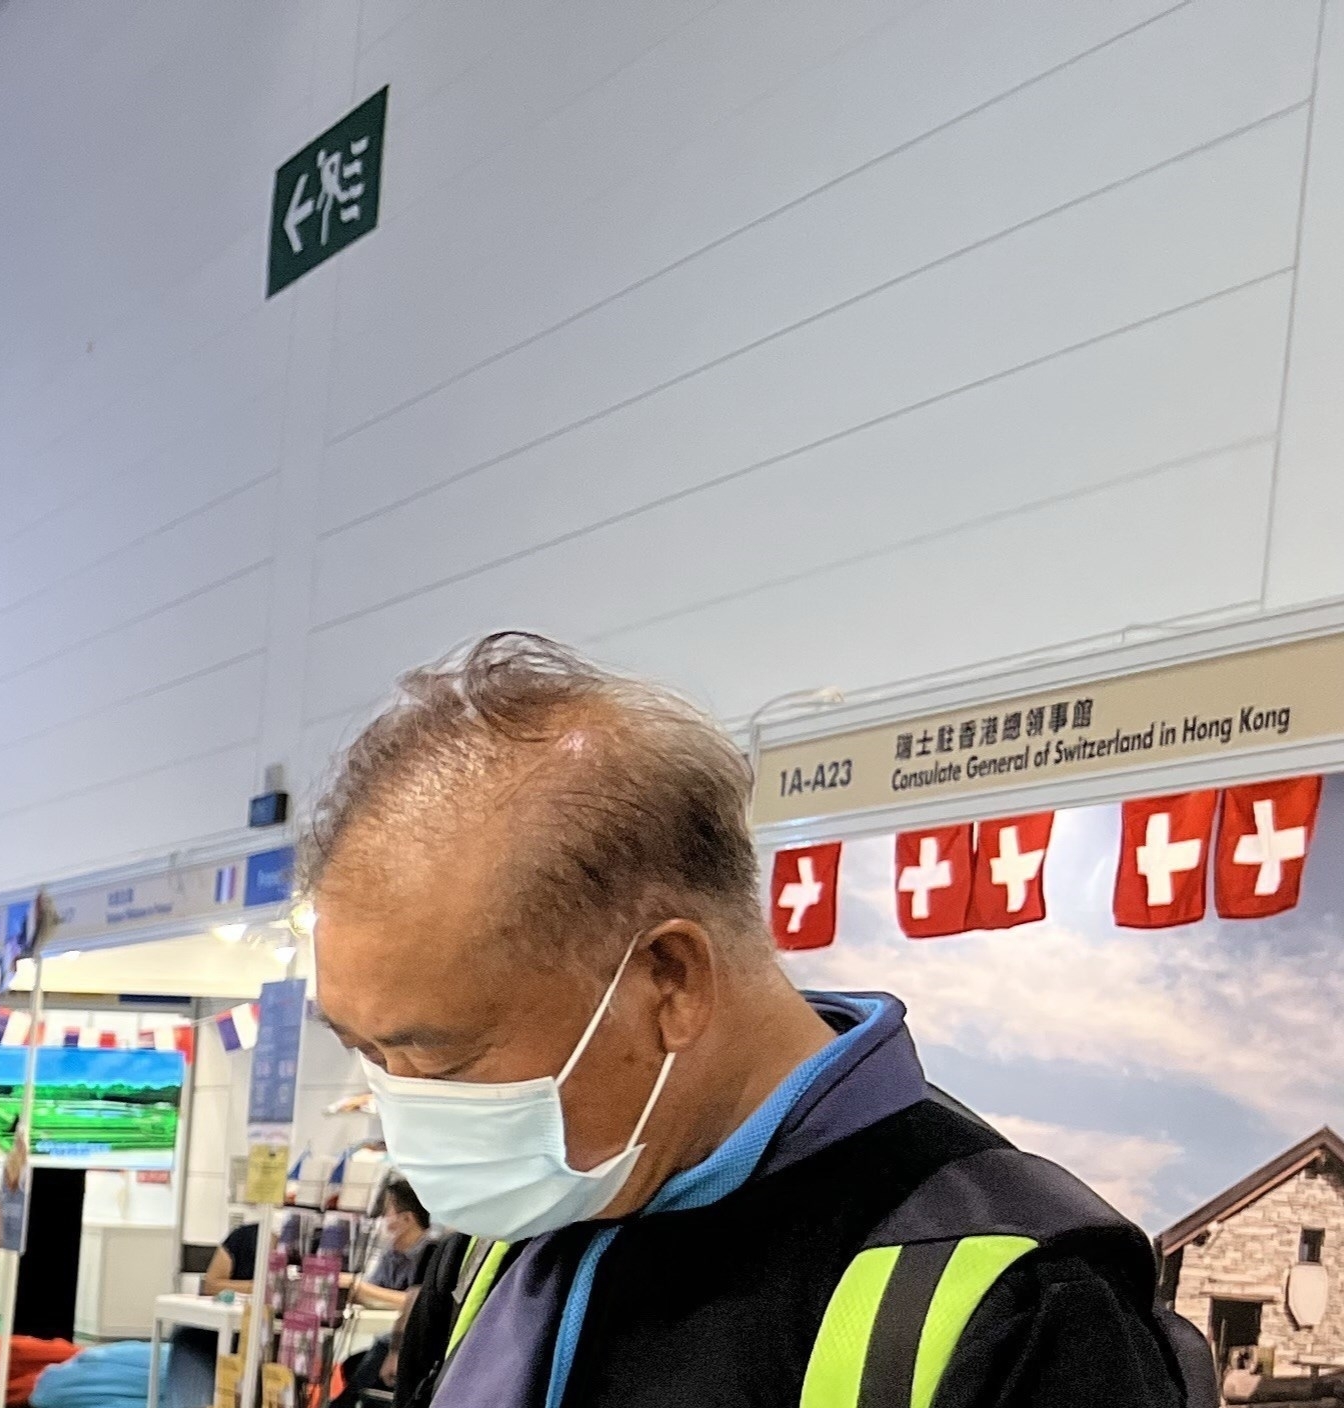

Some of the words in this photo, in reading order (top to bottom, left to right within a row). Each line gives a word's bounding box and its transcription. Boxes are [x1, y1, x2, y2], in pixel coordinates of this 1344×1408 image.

[892, 761, 961, 791] Consulate
[967, 745, 1029, 778] General
[1034, 741, 1050, 767] of
[1054, 721, 1155, 764] Switzerland
[1160, 721, 1176, 746] in
[1182, 716, 1232, 744] Hong
[1239, 706, 1291, 734] Kong
[895, 698, 1093, 760] 瑞士駐香港總領事館
[780, 759, 853, 796] 1A-A23
